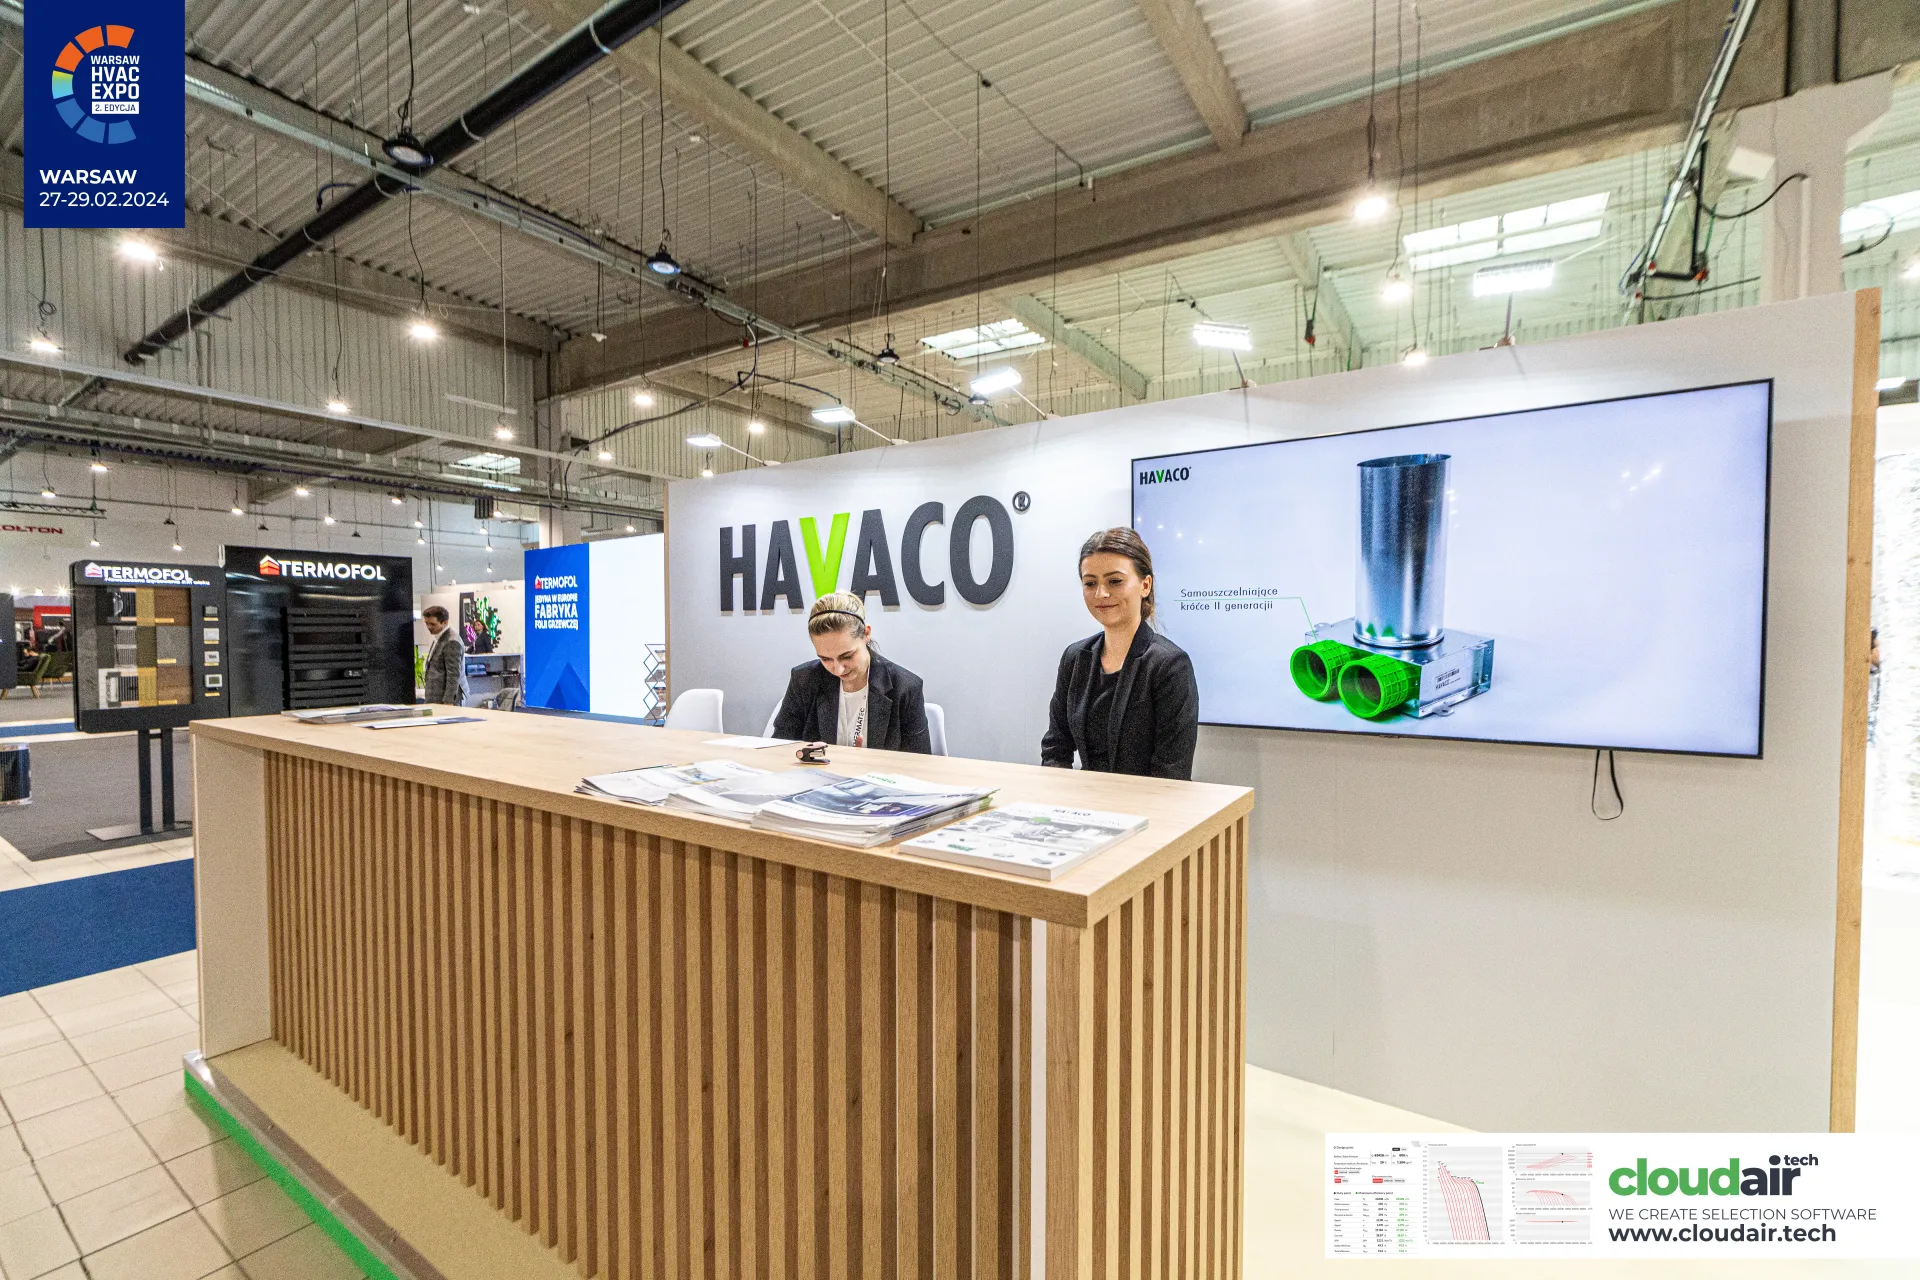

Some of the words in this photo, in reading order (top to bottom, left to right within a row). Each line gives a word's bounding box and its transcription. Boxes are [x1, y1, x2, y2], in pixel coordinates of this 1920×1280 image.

[1139, 467, 1190, 485] HAVACO
[0, 525, 63, 535] OLTON
[719, 495, 1014, 612] HAVACO
[101, 566, 193, 581] TERMOFOL
[279, 560, 386, 581] TERMOFOL
[541, 575, 578, 590] TERMOFOL
[557, 593, 578, 602] EUROPIE
[1180, 586, 1278, 598] Samouszczelniające
[534, 603, 578, 619] FABRYKA
